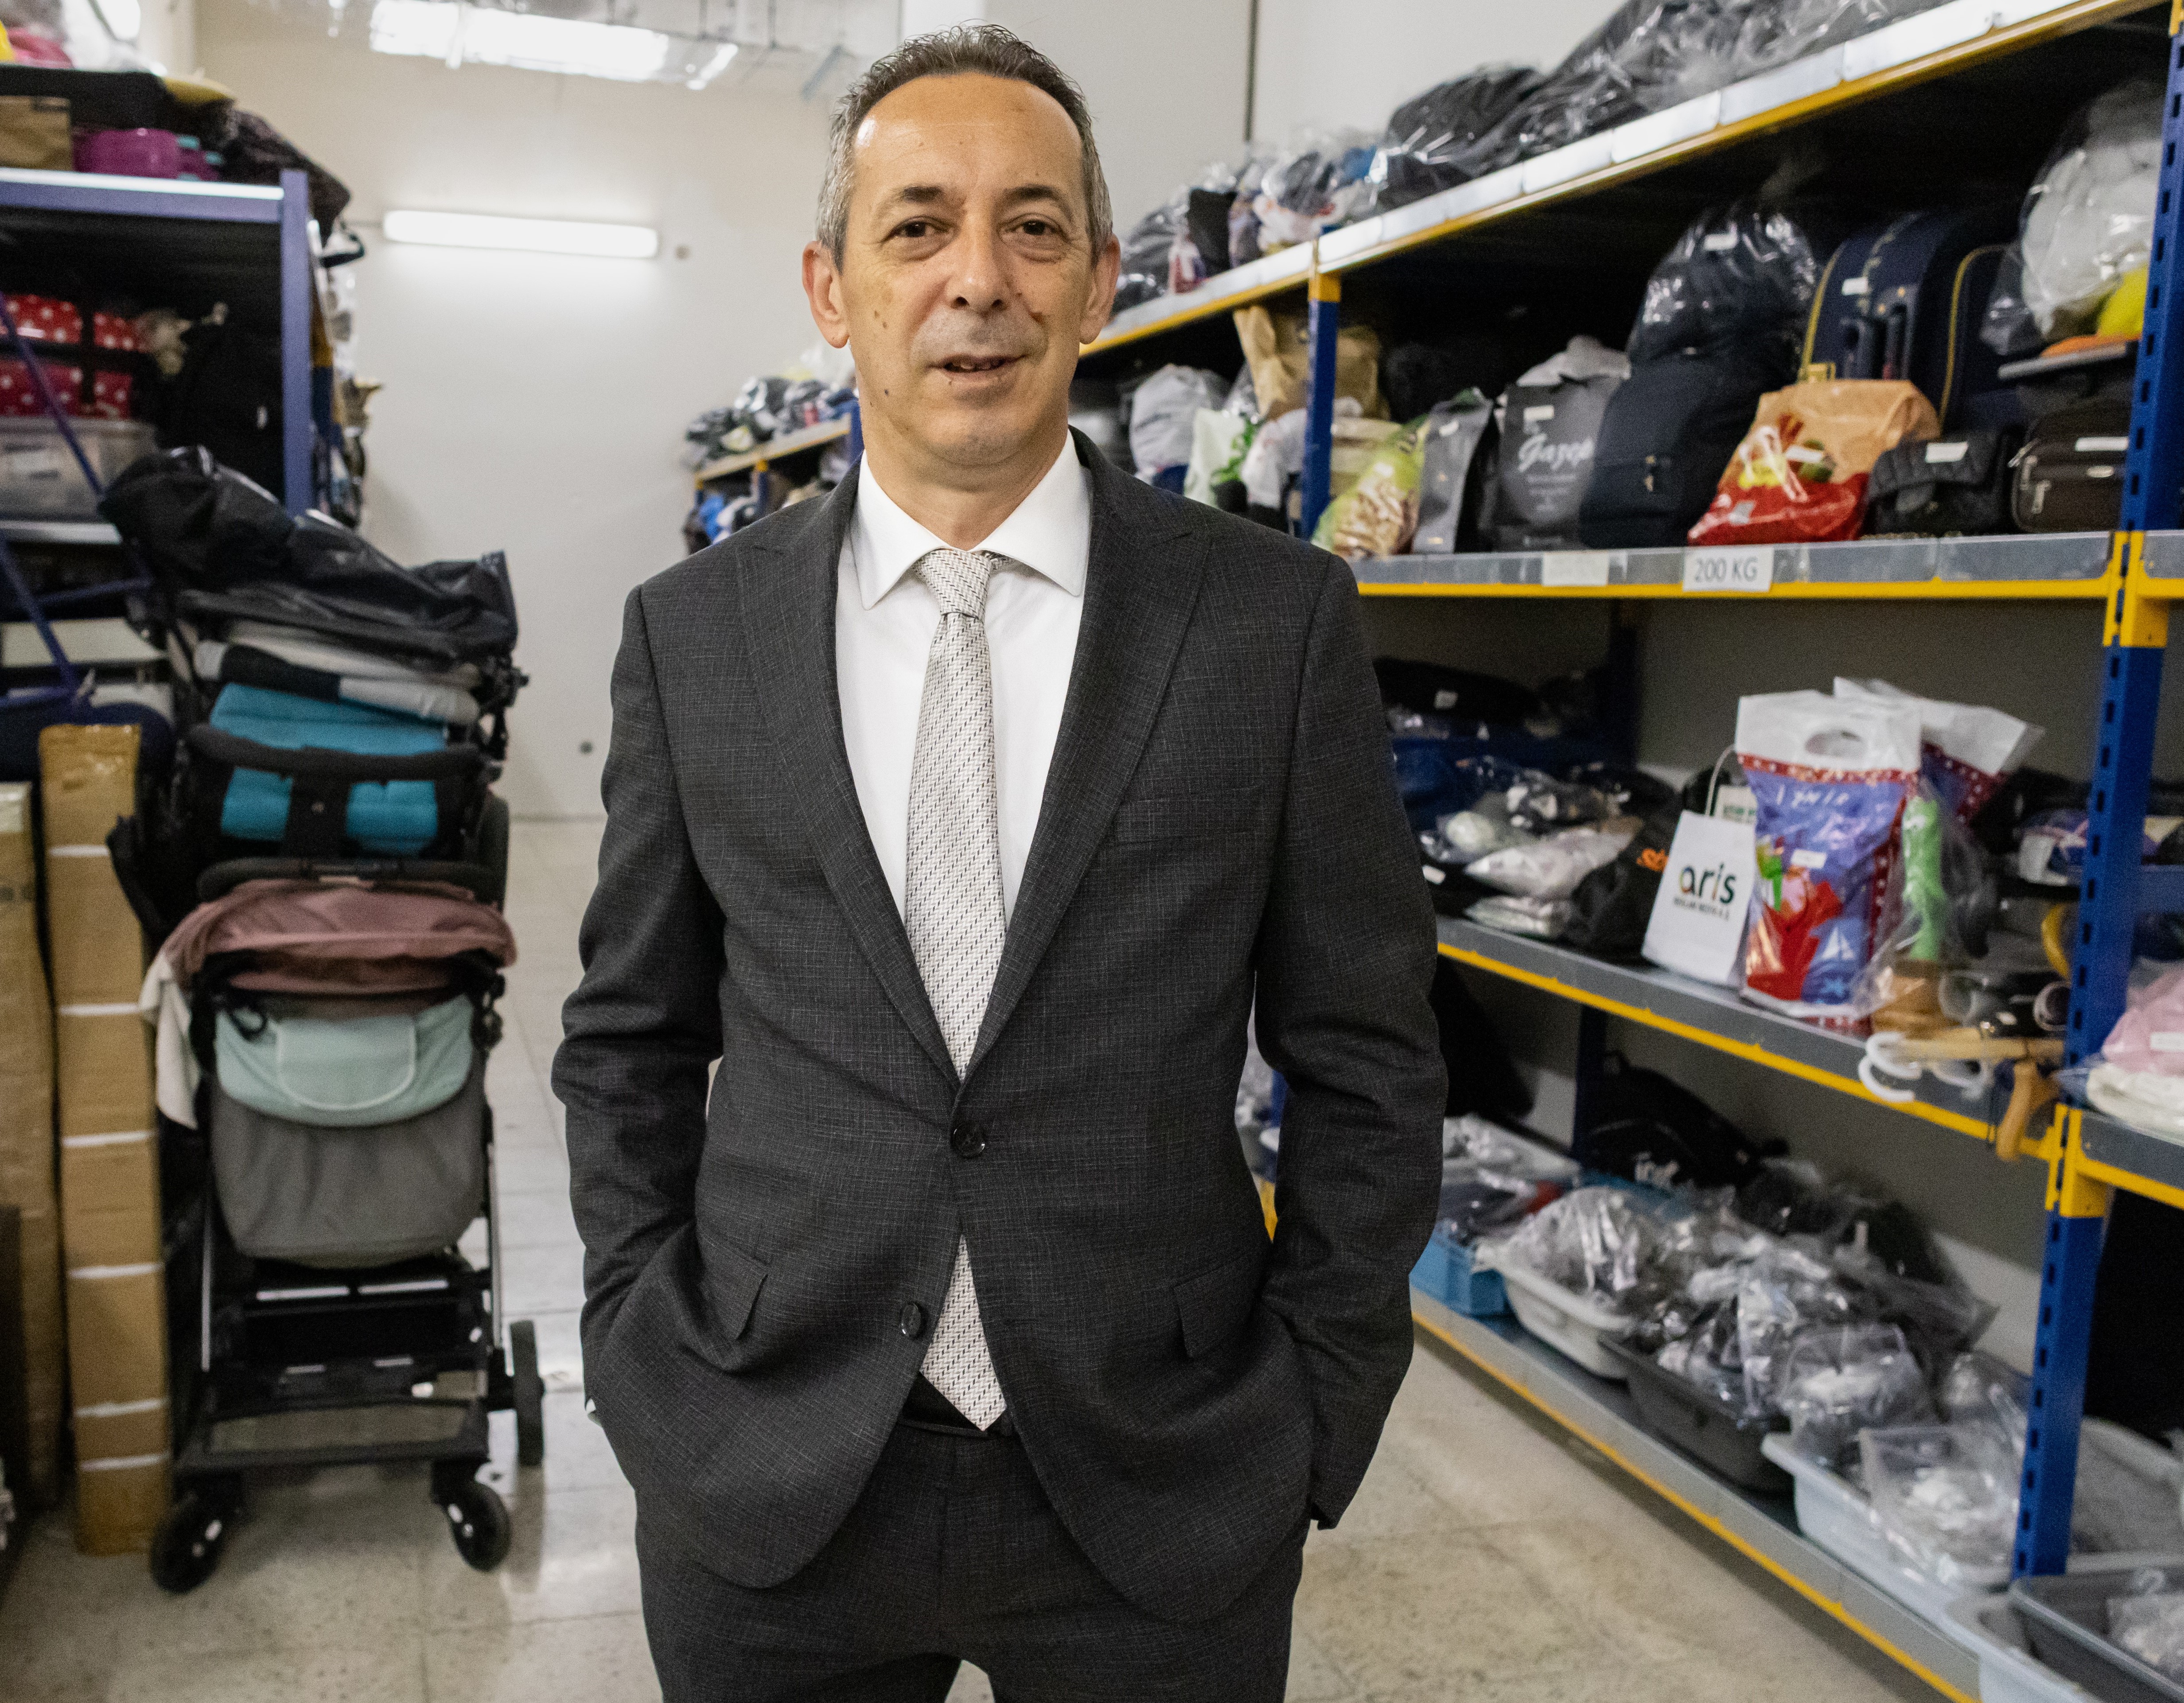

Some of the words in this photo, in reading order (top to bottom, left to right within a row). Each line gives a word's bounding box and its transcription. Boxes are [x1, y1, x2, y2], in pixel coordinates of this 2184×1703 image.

[1695, 557, 1726, 582] 200
[1732, 556, 1758, 582] KG
[1679, 862, 1736, 904] aris
